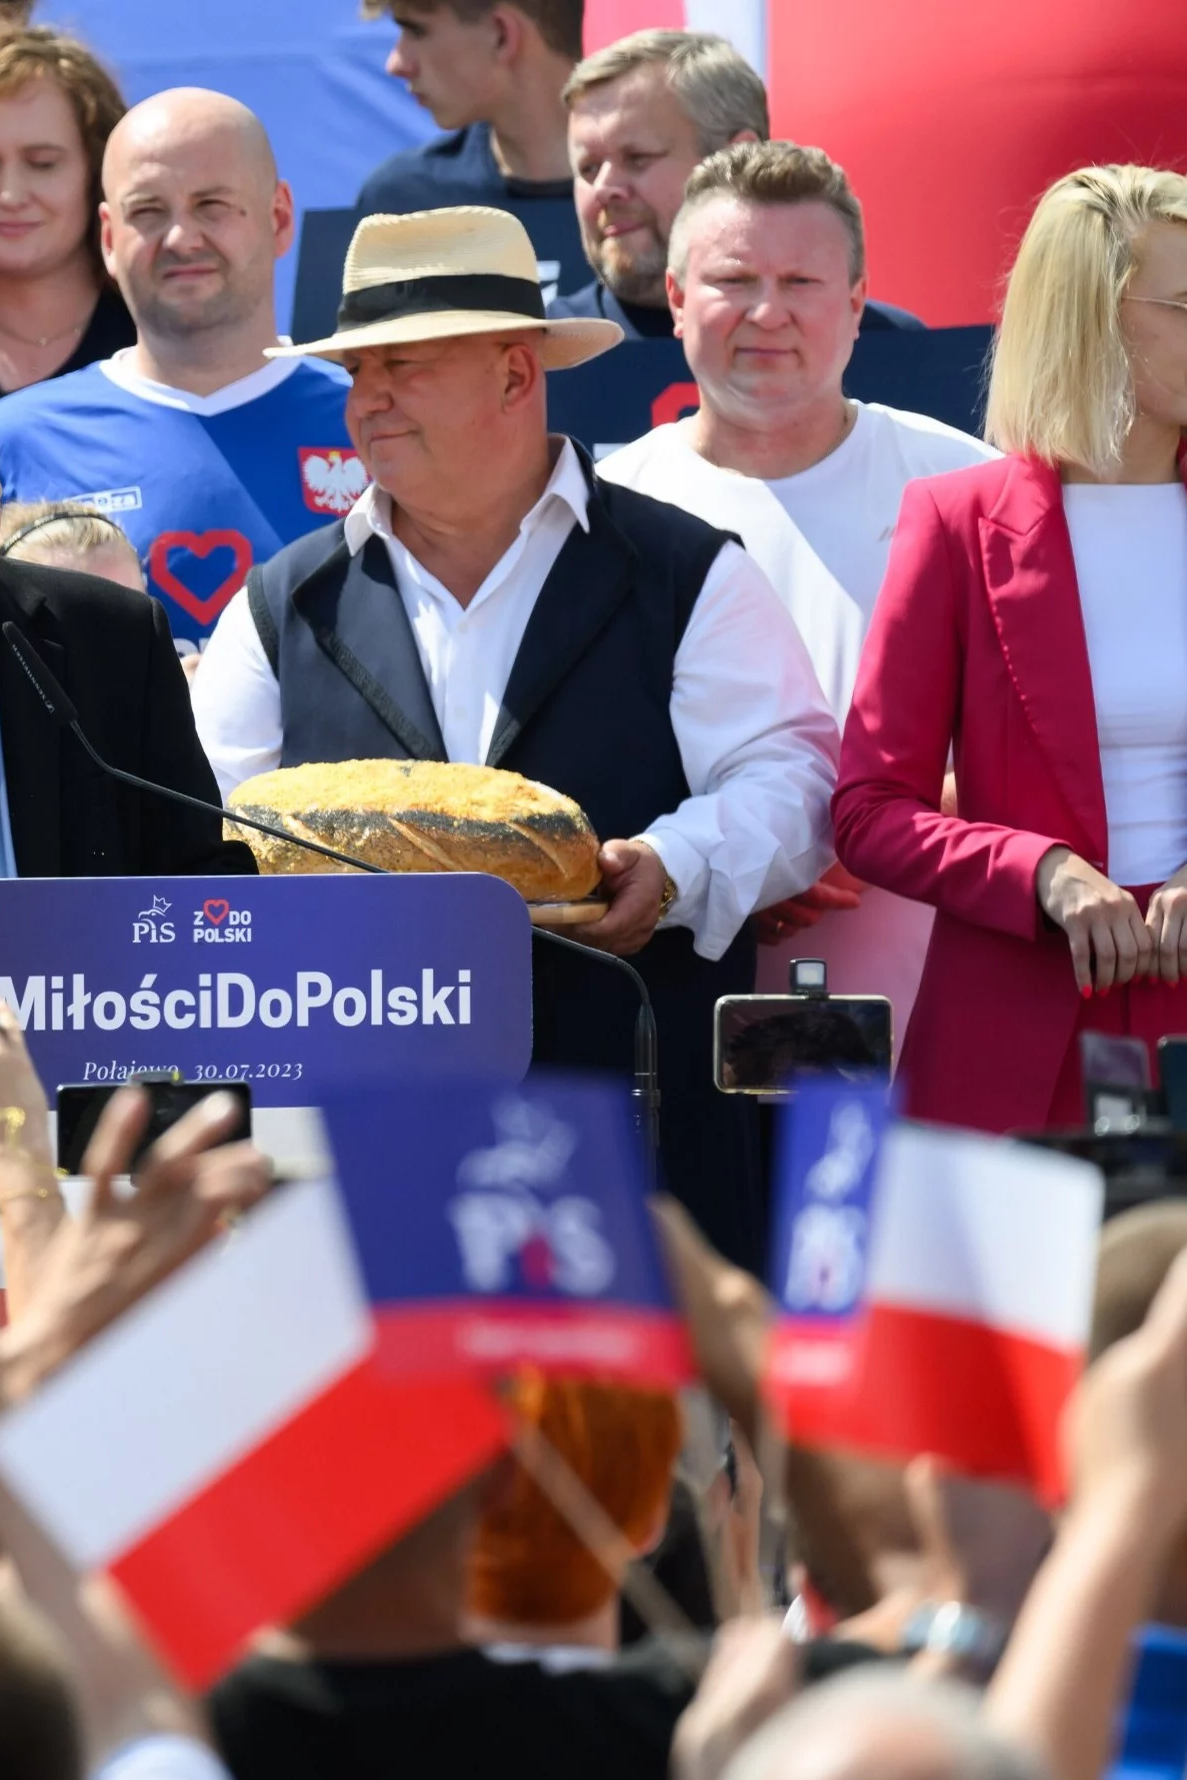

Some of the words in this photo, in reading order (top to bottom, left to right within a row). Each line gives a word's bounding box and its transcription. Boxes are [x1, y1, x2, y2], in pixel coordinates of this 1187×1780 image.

[193, 911, 205, 926] Z
[228, 910, 252, 926] DO
[132, 922, 176, 944] PiS
[193, 928, 252, 943] POLSKI
[194, 1062, 303, 1082] 30.07.2023
